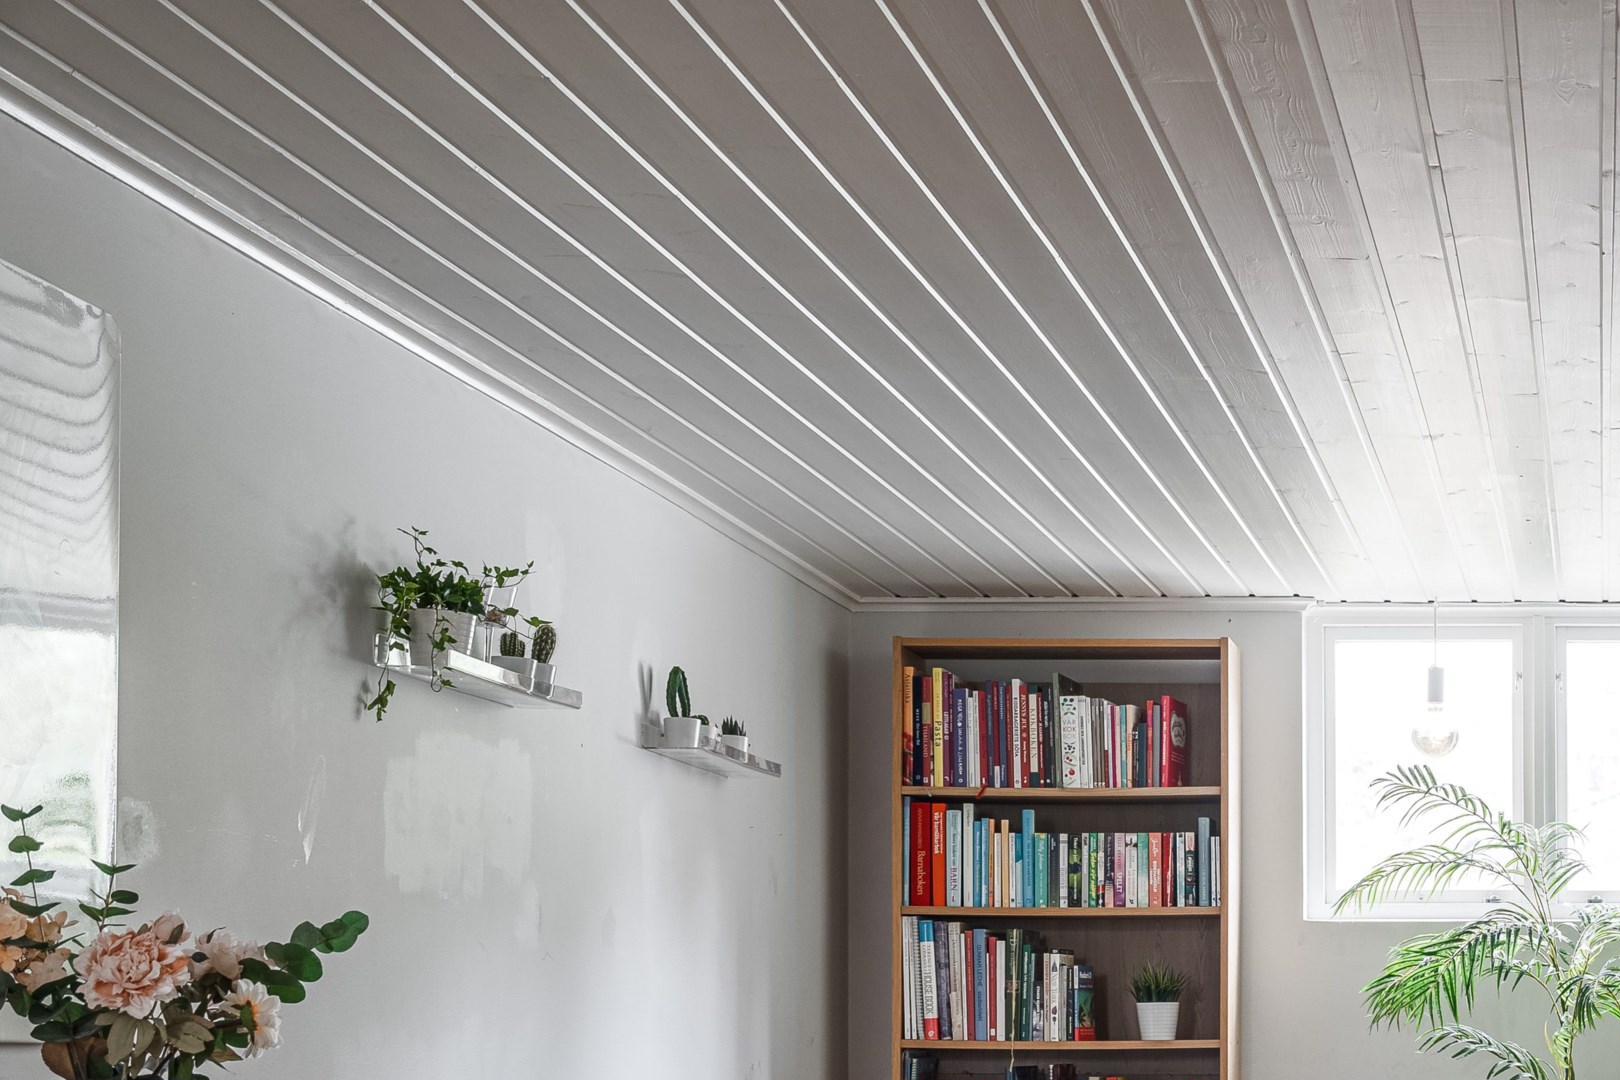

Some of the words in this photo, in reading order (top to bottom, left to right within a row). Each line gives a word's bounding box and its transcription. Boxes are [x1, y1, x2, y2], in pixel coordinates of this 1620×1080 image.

[934, 720, 942, 747] Pasta
[917, 851, 926, 895] Barnaboken
[923, 972, 933, 995] HOUSE
[925, 996, 934, 1015] BOOK
